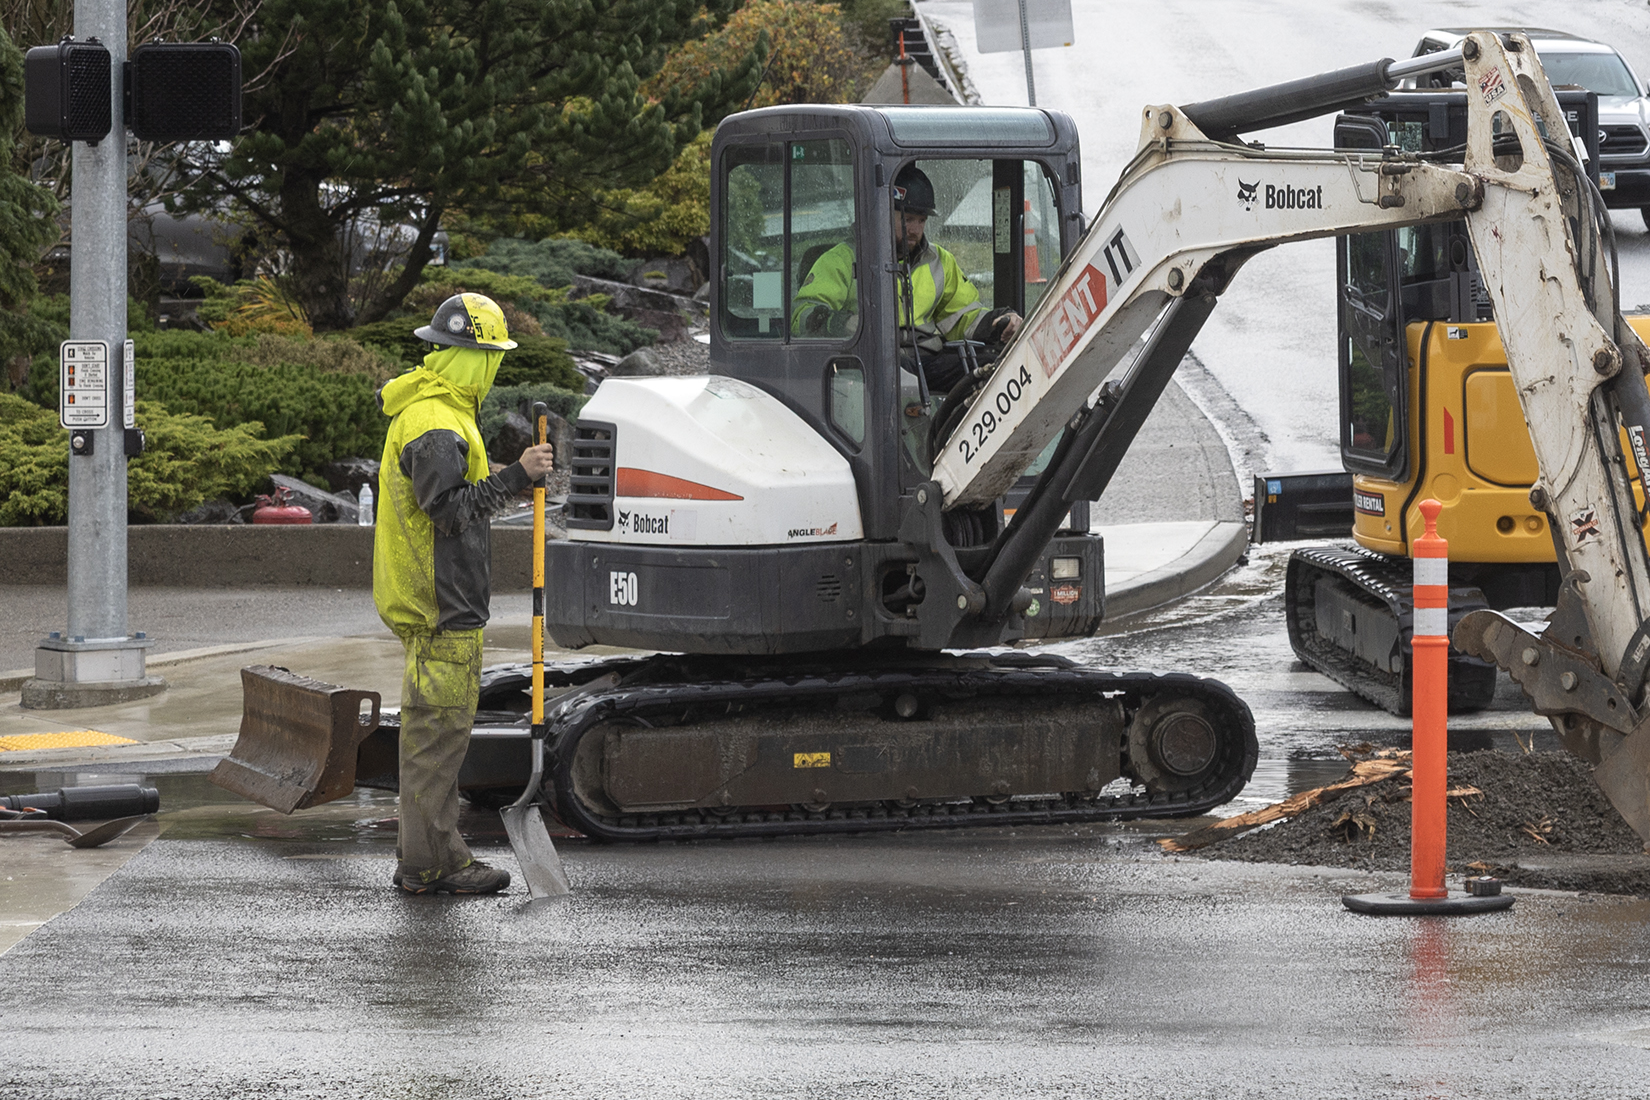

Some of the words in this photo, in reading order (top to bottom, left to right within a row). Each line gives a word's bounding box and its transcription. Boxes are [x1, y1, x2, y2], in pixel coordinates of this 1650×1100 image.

[1265, 184, 1323, 210] Bobcat
[1103, 228, 1134, 288] IT
[958, 364, 1033, 465] 2.29.004
[1363, 497, 1384, 512] RENTAL
[633, 513, 669, 534] Bobcat
[609, 571, 638, 607] E50
